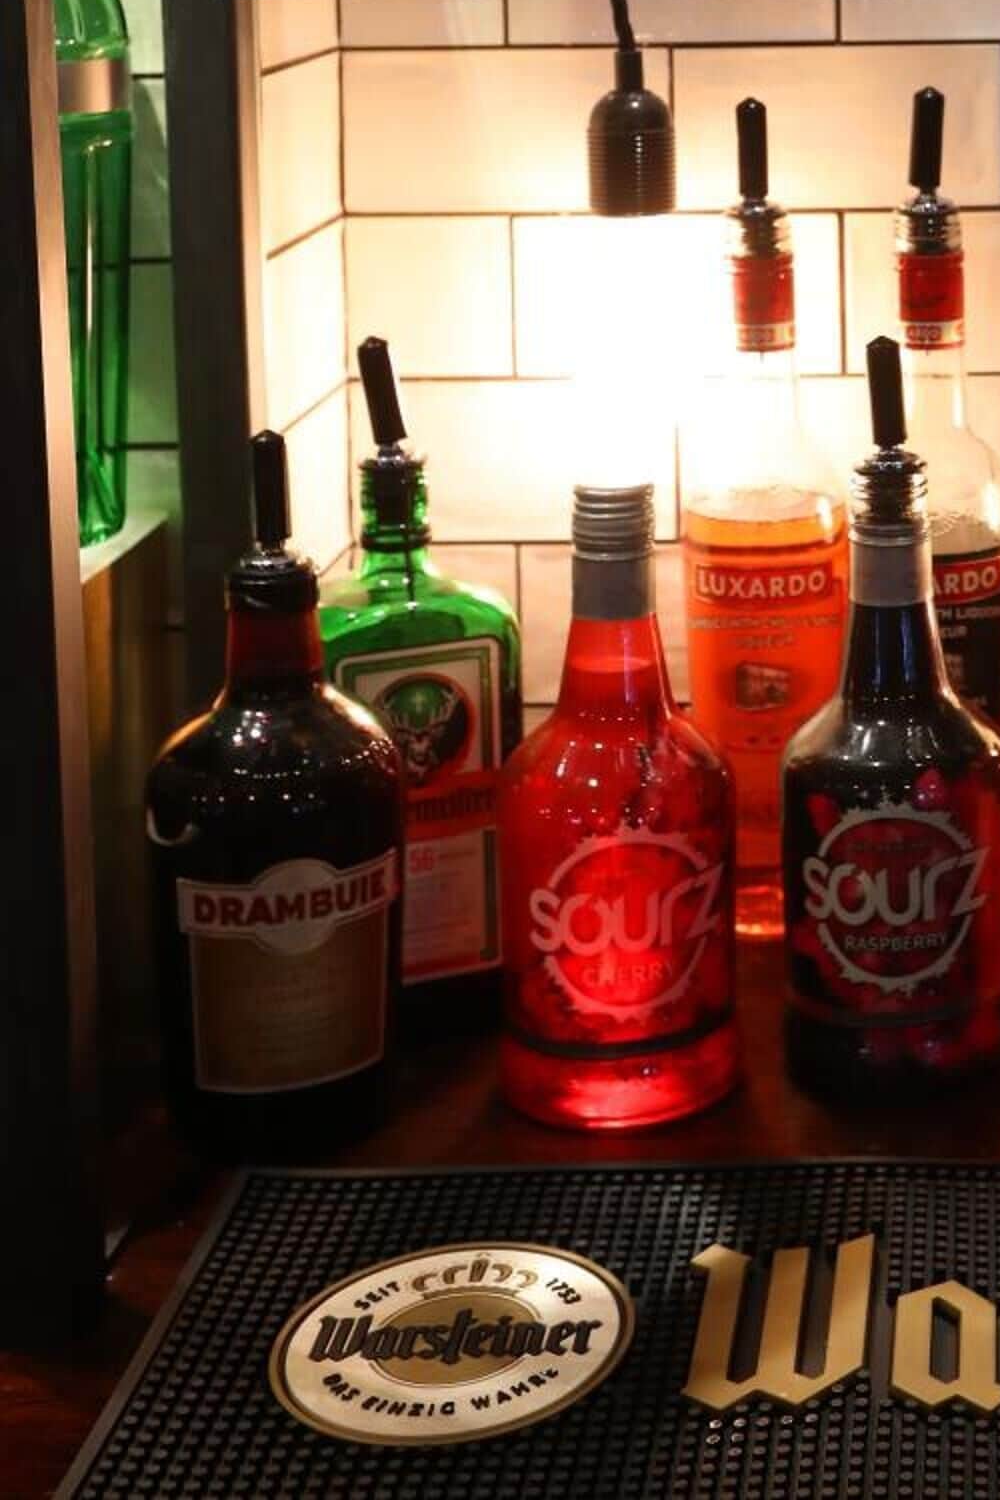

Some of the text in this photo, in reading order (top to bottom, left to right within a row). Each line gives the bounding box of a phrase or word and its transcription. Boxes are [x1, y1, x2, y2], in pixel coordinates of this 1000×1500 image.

[699, 569, 826, 598] LUXARDO
[933, 566, 997, 595] ARDO
[194, 866, 386, 926] DRAMBUIE
[845, 931, 947, 950] RASPBERRY
[354, 1277, 583, 1311] SEIT 1753
[308, 1308, 602, 1365] Warsteiner
[322, 1372, 361, 1402] DAS
[470, 1367, 560, 1411] WAHRE
